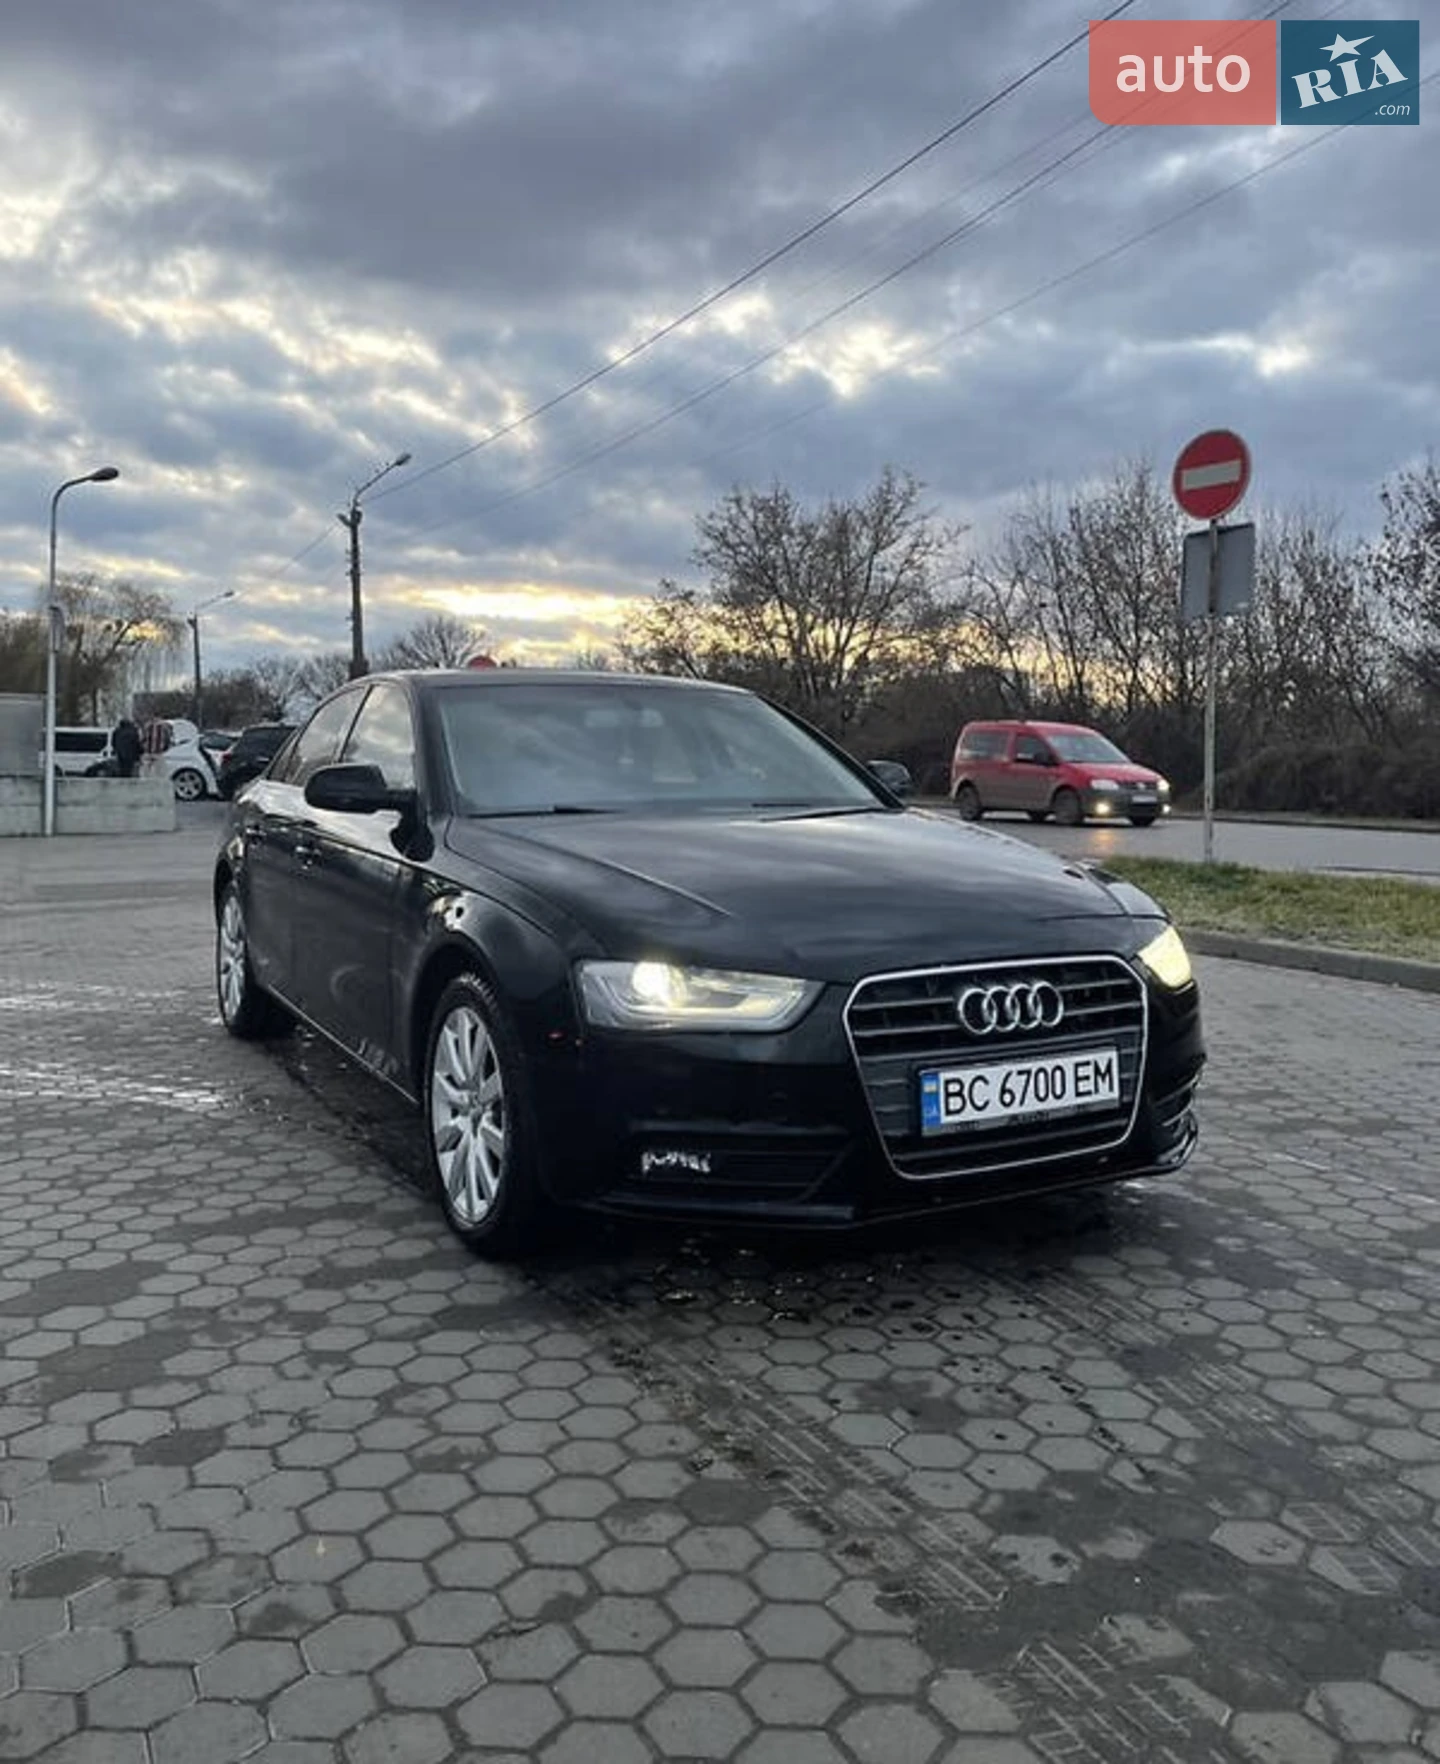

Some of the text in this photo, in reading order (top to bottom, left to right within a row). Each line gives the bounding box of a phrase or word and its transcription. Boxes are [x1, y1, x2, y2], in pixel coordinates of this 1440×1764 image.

[944, 1058, 1114, 1116] BC 6700 EM
